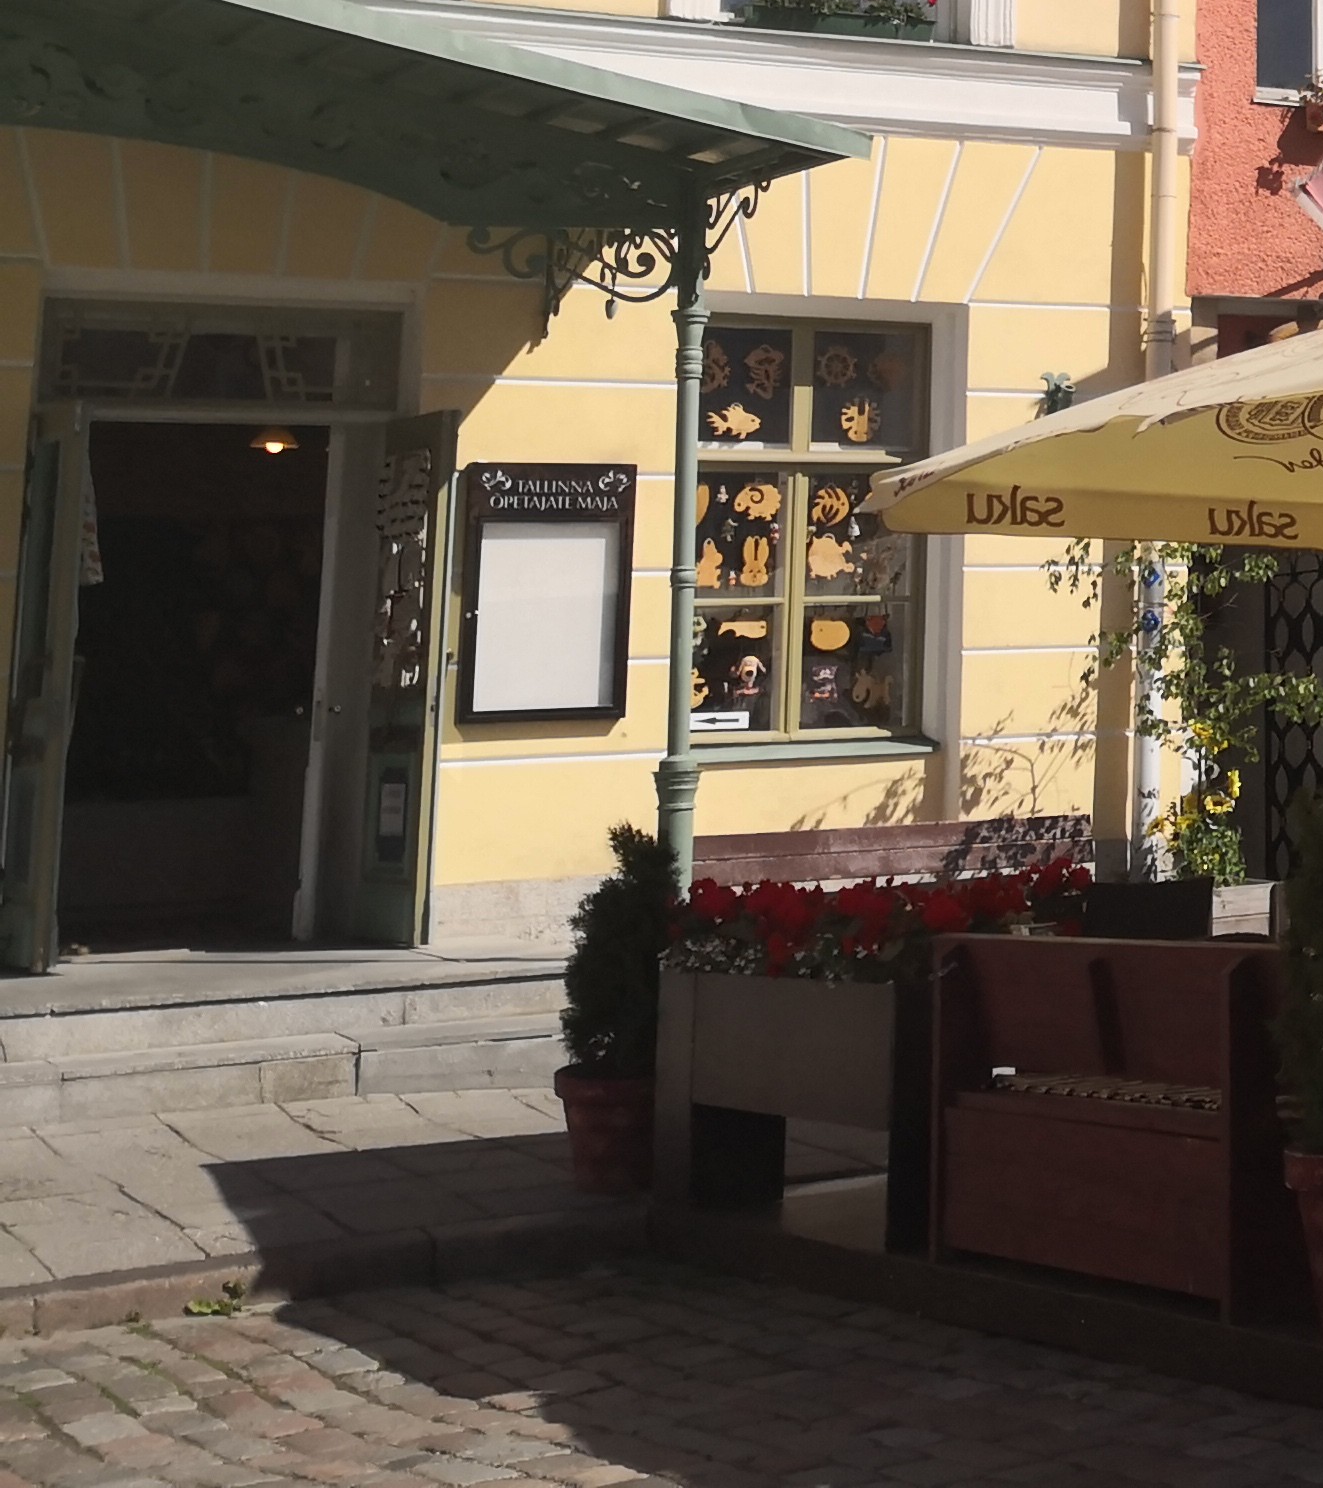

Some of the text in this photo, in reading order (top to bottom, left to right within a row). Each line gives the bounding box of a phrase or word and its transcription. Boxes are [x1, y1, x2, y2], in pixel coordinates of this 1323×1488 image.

[517, 479, 594, 493] TALLINNA
[489, 494, 619, 511] ÕPETAJATE MAJA
